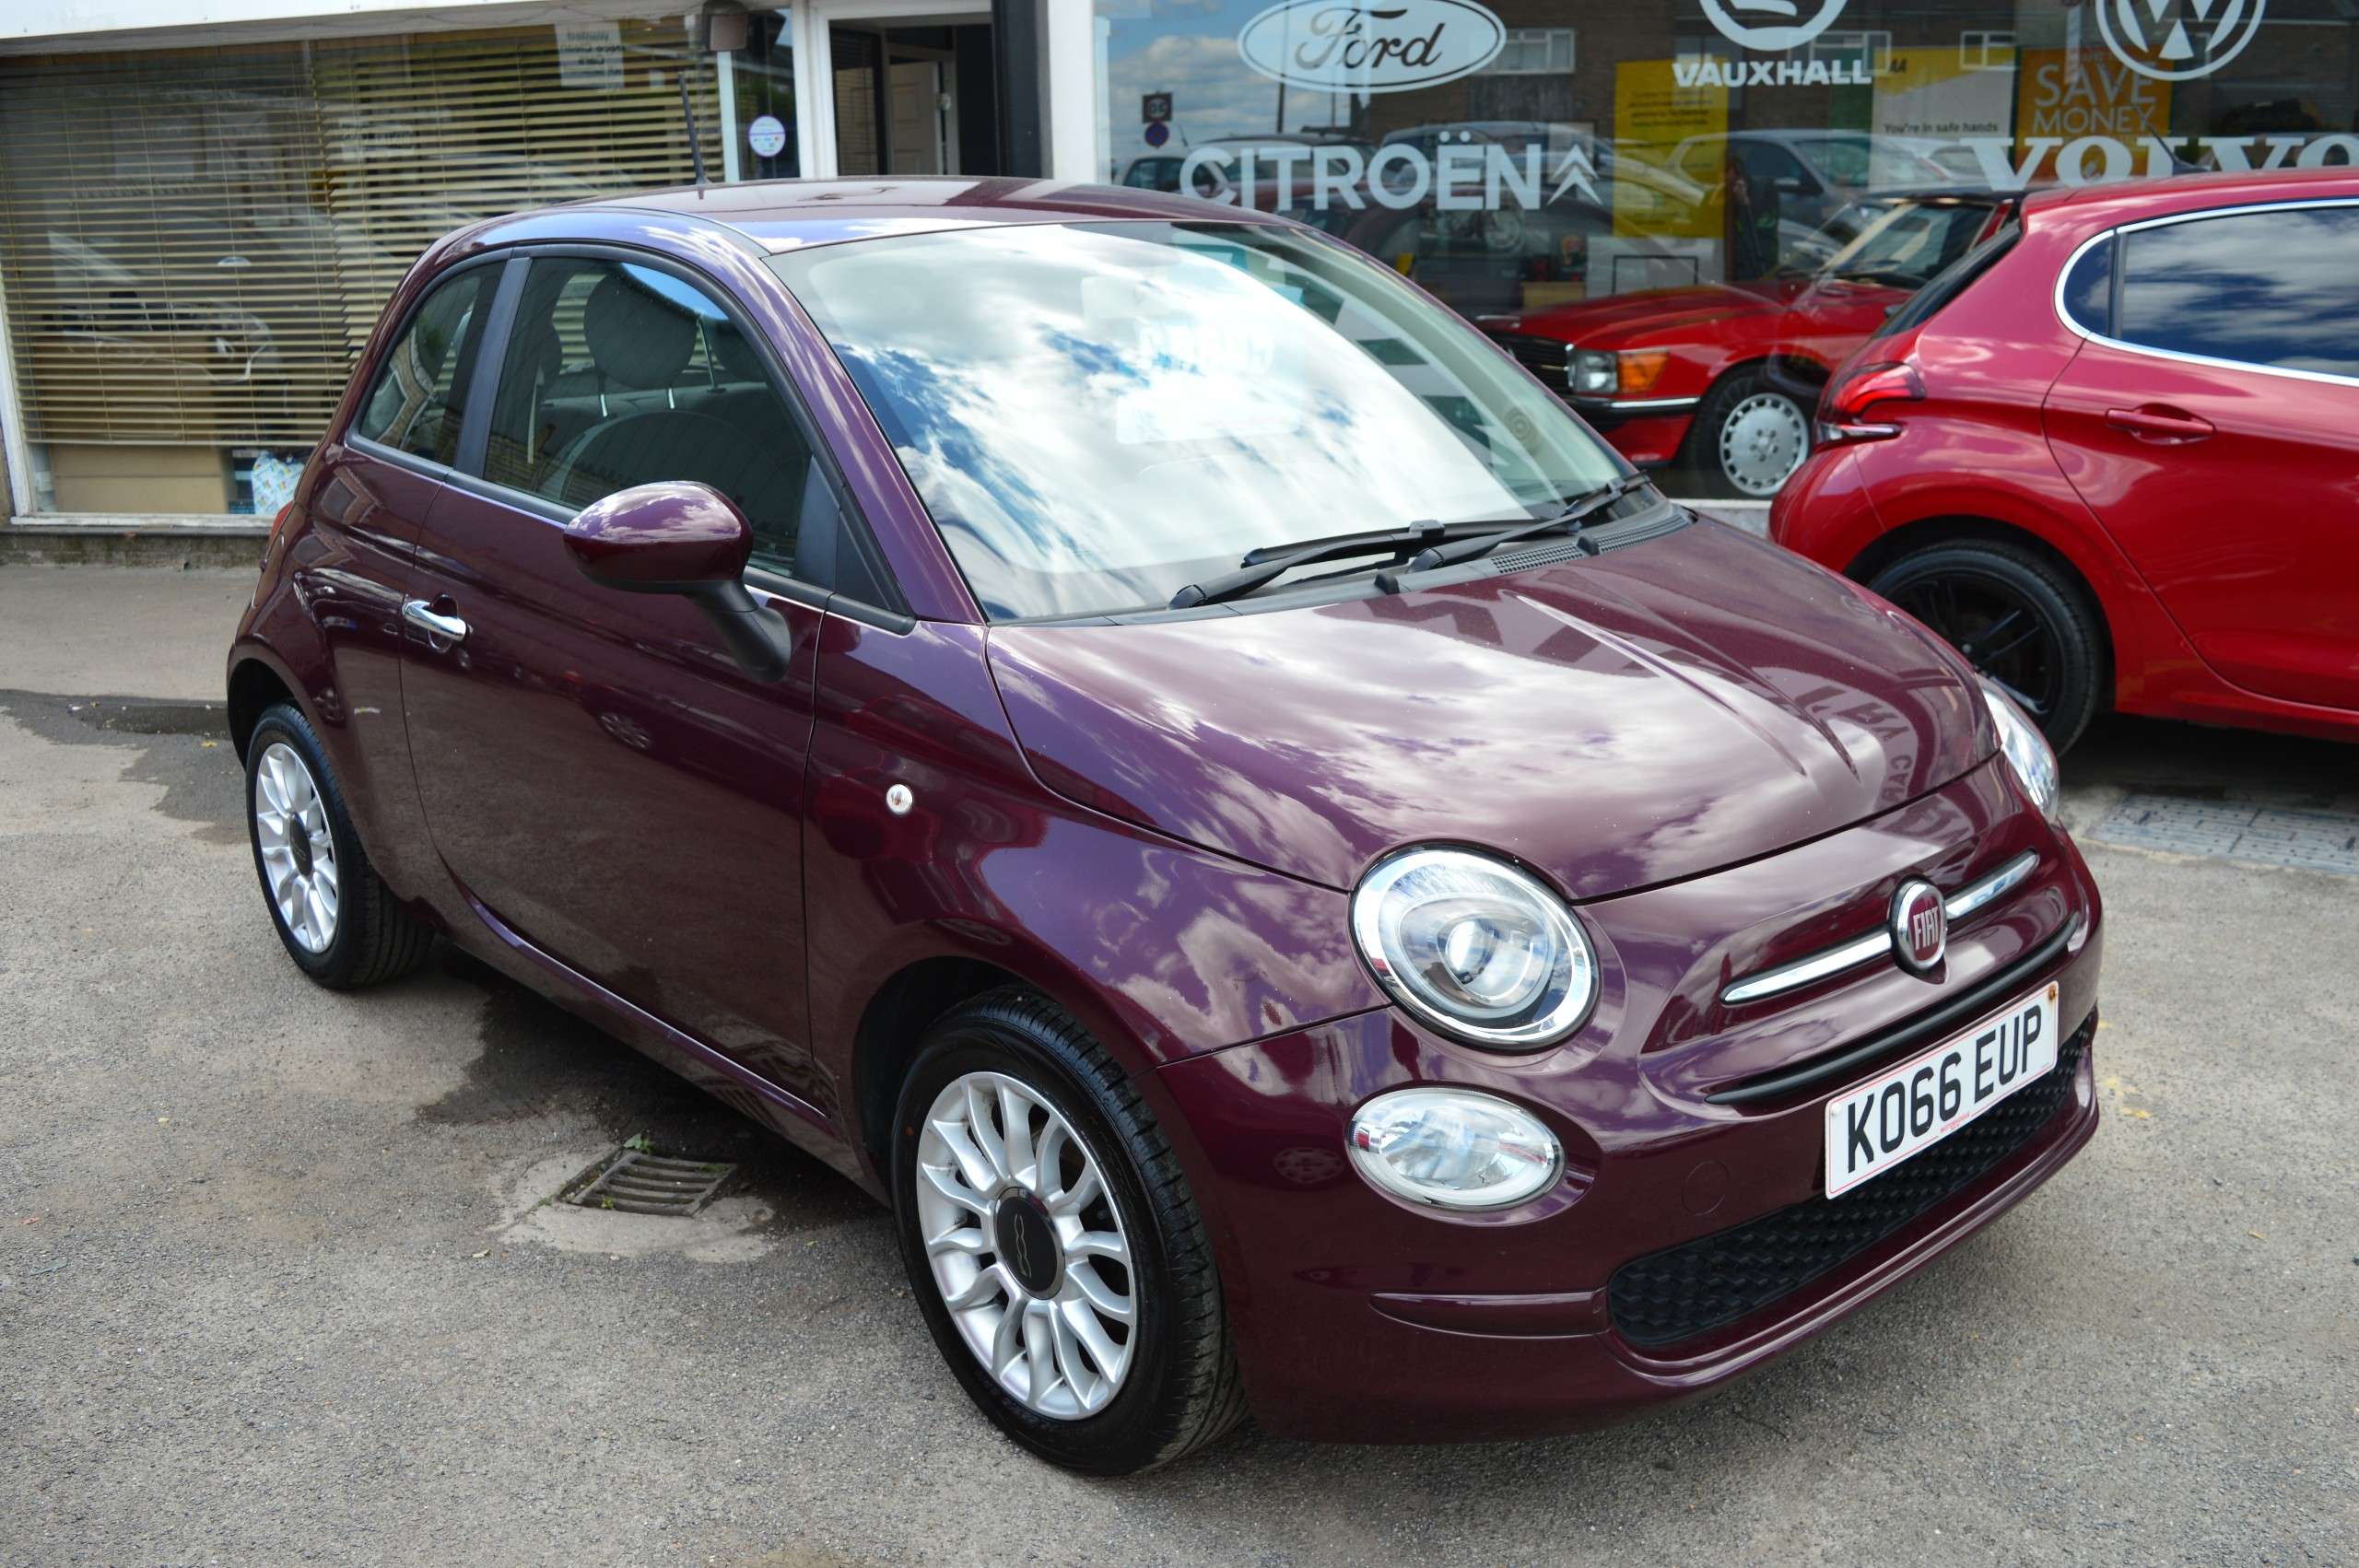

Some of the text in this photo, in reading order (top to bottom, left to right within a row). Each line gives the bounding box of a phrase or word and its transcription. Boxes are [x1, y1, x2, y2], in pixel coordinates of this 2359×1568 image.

[1295, 7, 1446, 70] Ford
[1672, 59, 1872, 88] VAUXHALL
[2034, 61, 2157, 108] SAVE
[1883, 120, 1999, 134] You're in safe hands
[2032, 104, 2156, 134] MONEY
[1180, 131, 1542, 211] CITROËN
[1912, 906, 1939, 951] FIAT
[1848, 1004, 2042, 1174] KO66 EUP
